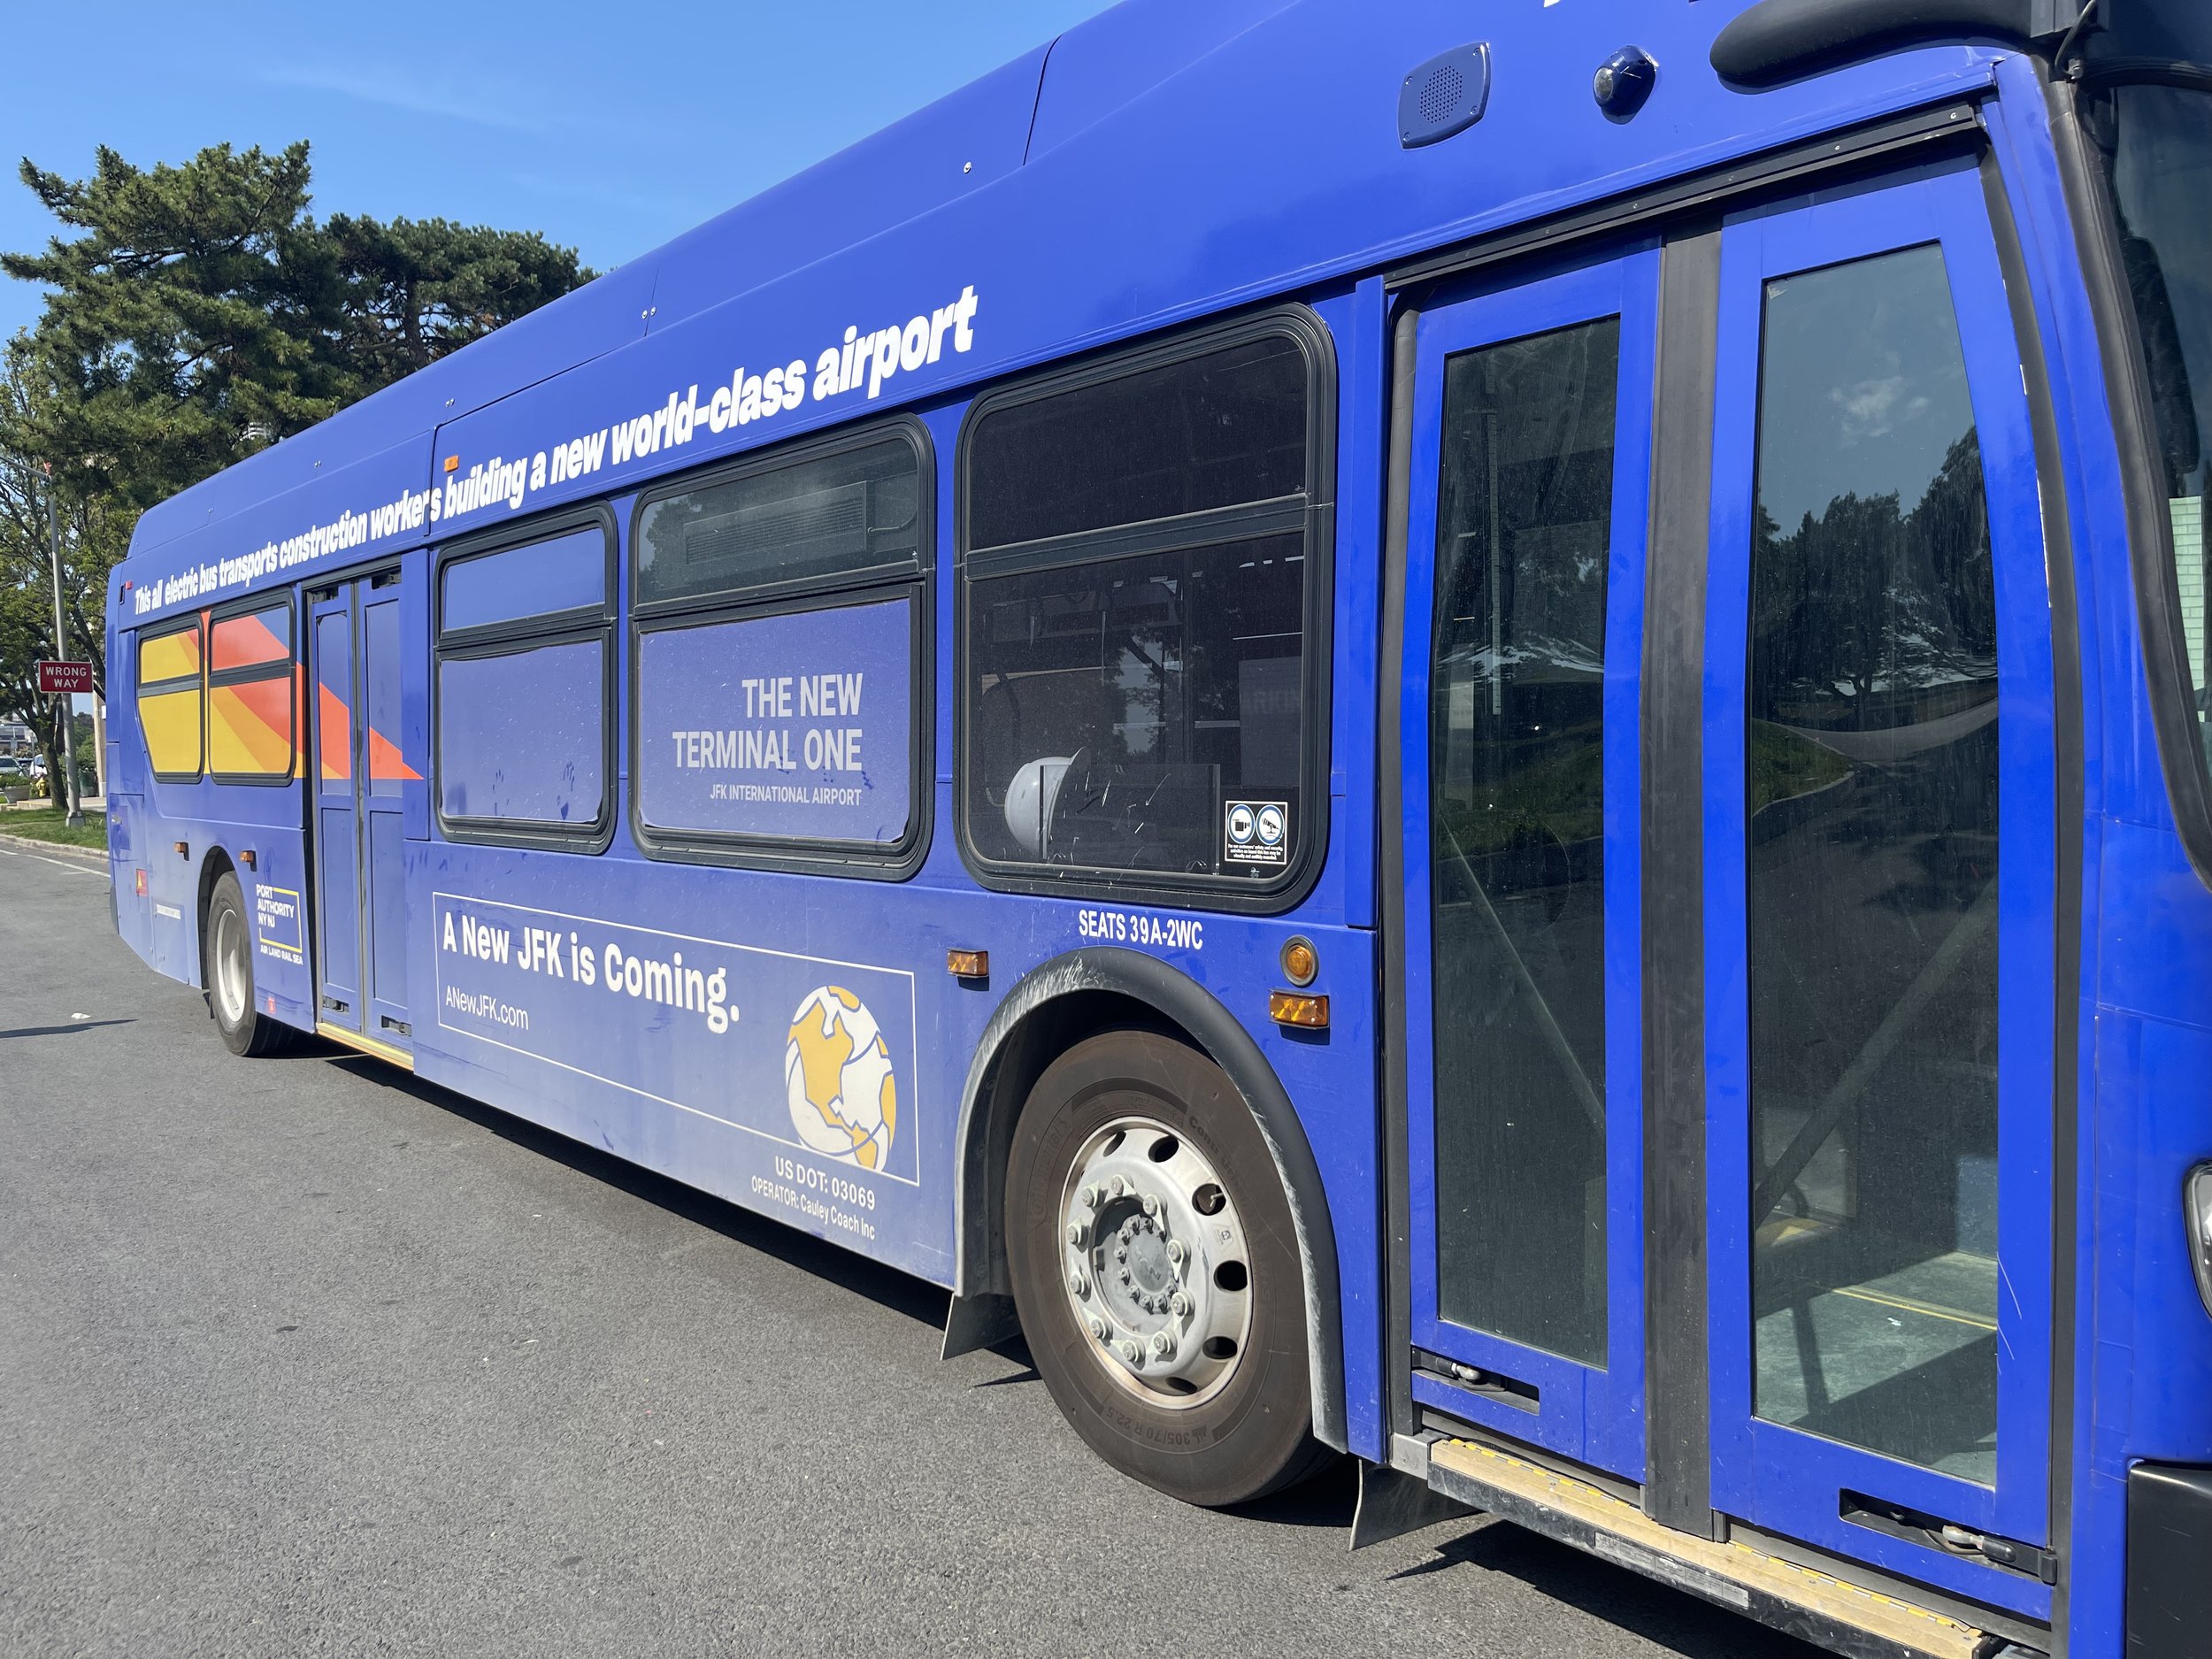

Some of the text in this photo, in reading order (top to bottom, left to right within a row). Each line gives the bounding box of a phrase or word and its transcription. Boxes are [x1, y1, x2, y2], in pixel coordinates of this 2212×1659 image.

[135, 284, 979, 615] This all electric bus transports construction workers building a new world-class airport
[45, 666, 87, 677] WRONG
[54, 679, 79, 688] WAY
[741, 672, 864, 718] THE NEW
[672, 728, 863, 772] TERMINAL ONE
[710, 784, 862, 806] JFK INTERNATIONAL AIRPORT
[256, 884, 273, 899] PORT
[257, 899, 294, 918] AUTHORITY
[258, 912, 275, 927] NY NJ
[1079, 910, 1203, 950] SEATS 39A-2WC
[269, 947, 281, 958] LAND
[282, 950, 292, 962] RAIL
[293, 954, 303, 965] SEA
[443, 912, 740, 1034] A New JFK is Coming.
[446, 985, 529, 1030] ANewJFK.com
[775, 1156, 876, 1210] US DOT: 03069
[751, 1175, 876, 1240] OPERATOR: Cauley Coach Inc
[1146, 1427, 1191, 1446] 305/70
